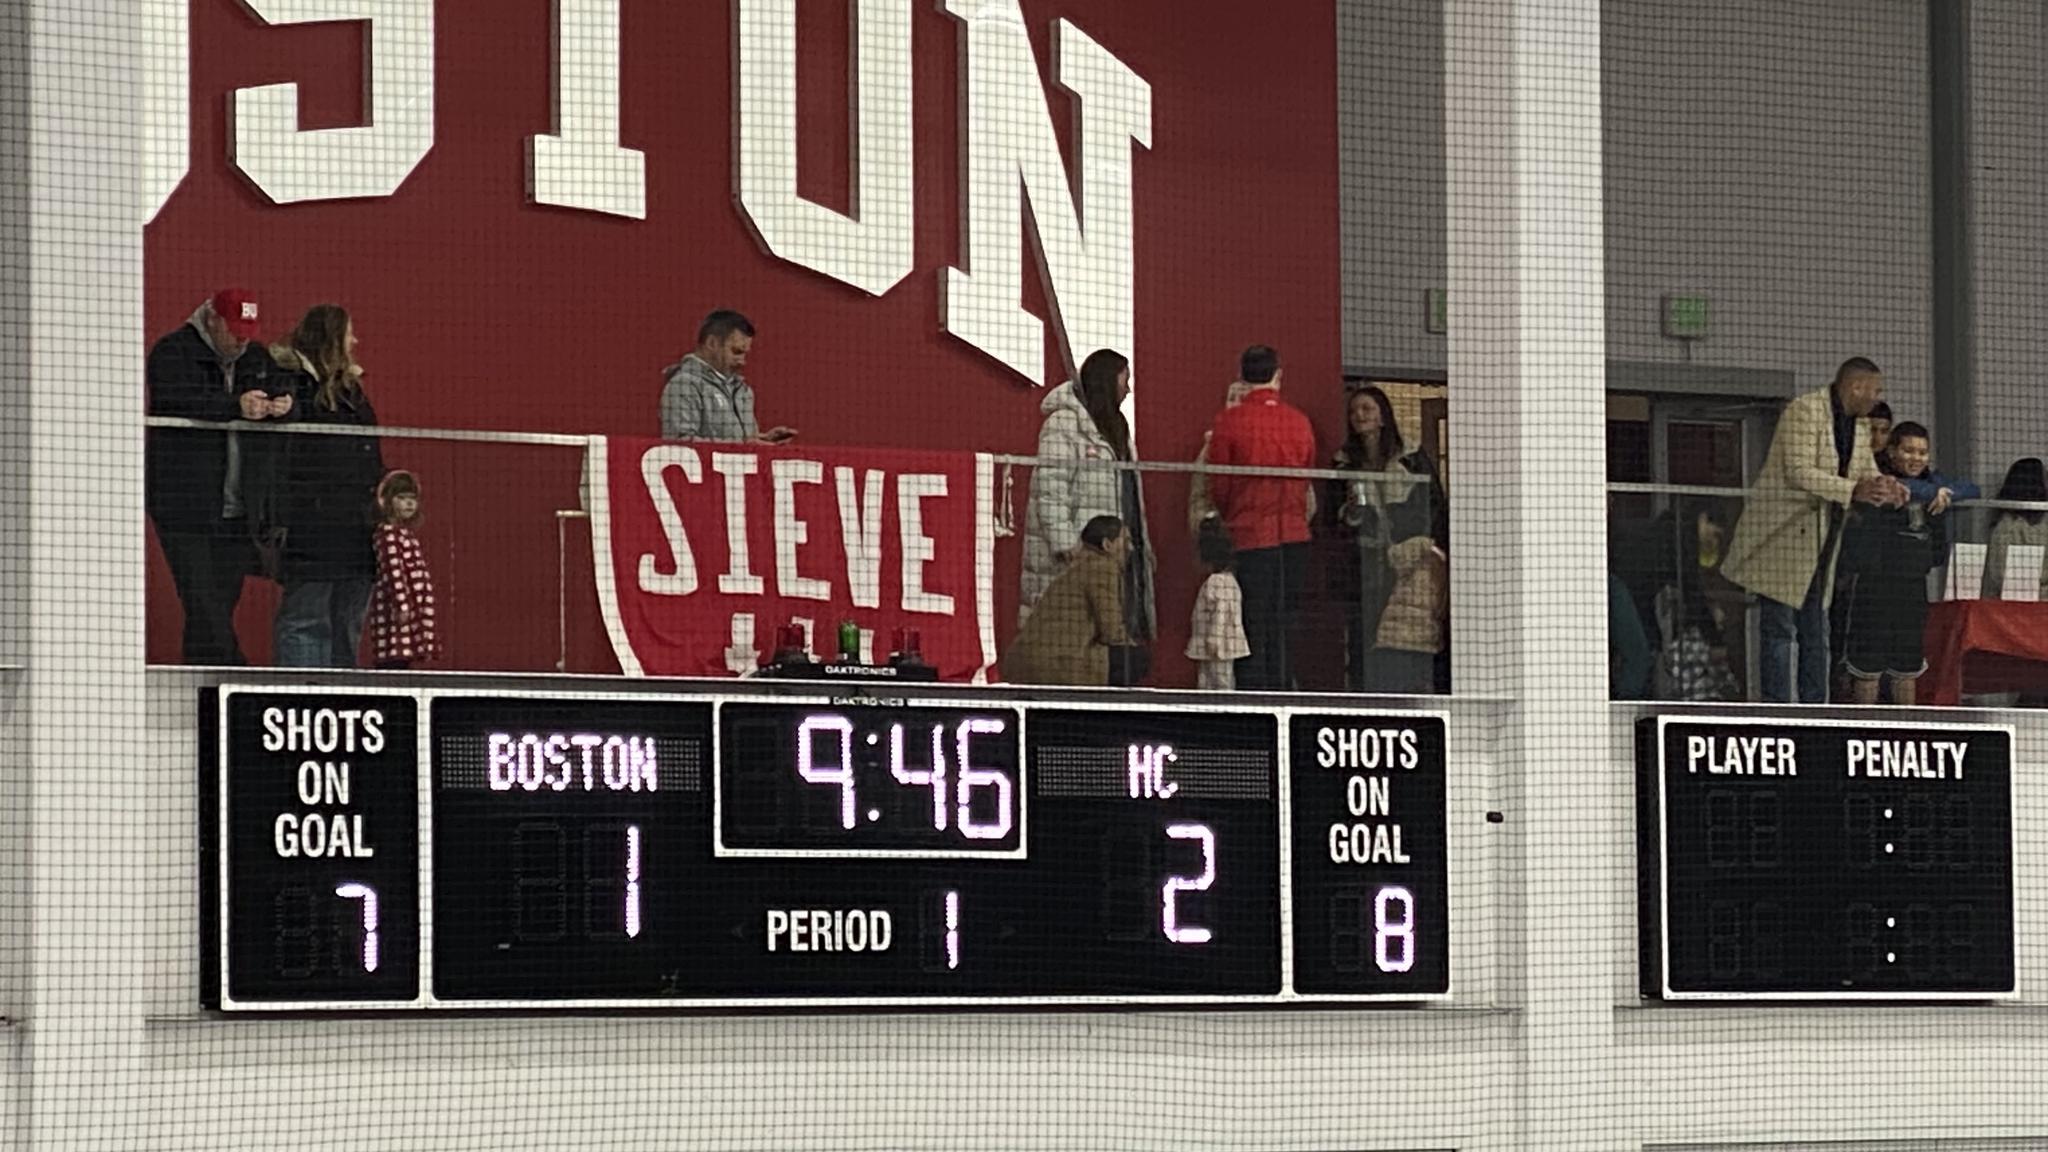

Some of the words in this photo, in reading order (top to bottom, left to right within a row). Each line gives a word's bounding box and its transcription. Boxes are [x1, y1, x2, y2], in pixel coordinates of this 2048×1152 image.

[638, 445, 954, 616] SIEVE
[825, 665, 897, 676] DAKTRONICS
[263, 707, 385, 753] SHOTS
[1317, 728, 1419, 769] SHOTS
[1688, 736, 1797, 776] PLAYER
[1847, 739, 1968, 779] PENALTY
[298, 761, 349, 805] ON
[488, 733, 658, 792] BOSTON
[797, 715, 1012, 839] 9:46
[1128, 744, 1179, 799] HC
[1347, 776, 1390, 816] ON
[274, 813, 374, 858] GOAL
[1329, 823, 1411, 864] GOAL
[624, 825, 641, 939] 1
[1162, 824, 1216, 943] 2
[335, 883, 379, 973] 7
[767, 909, 892, 952] PERIOD
[945, 891, 959, 970] 1
[1373, 886, 1416, 973] 8
